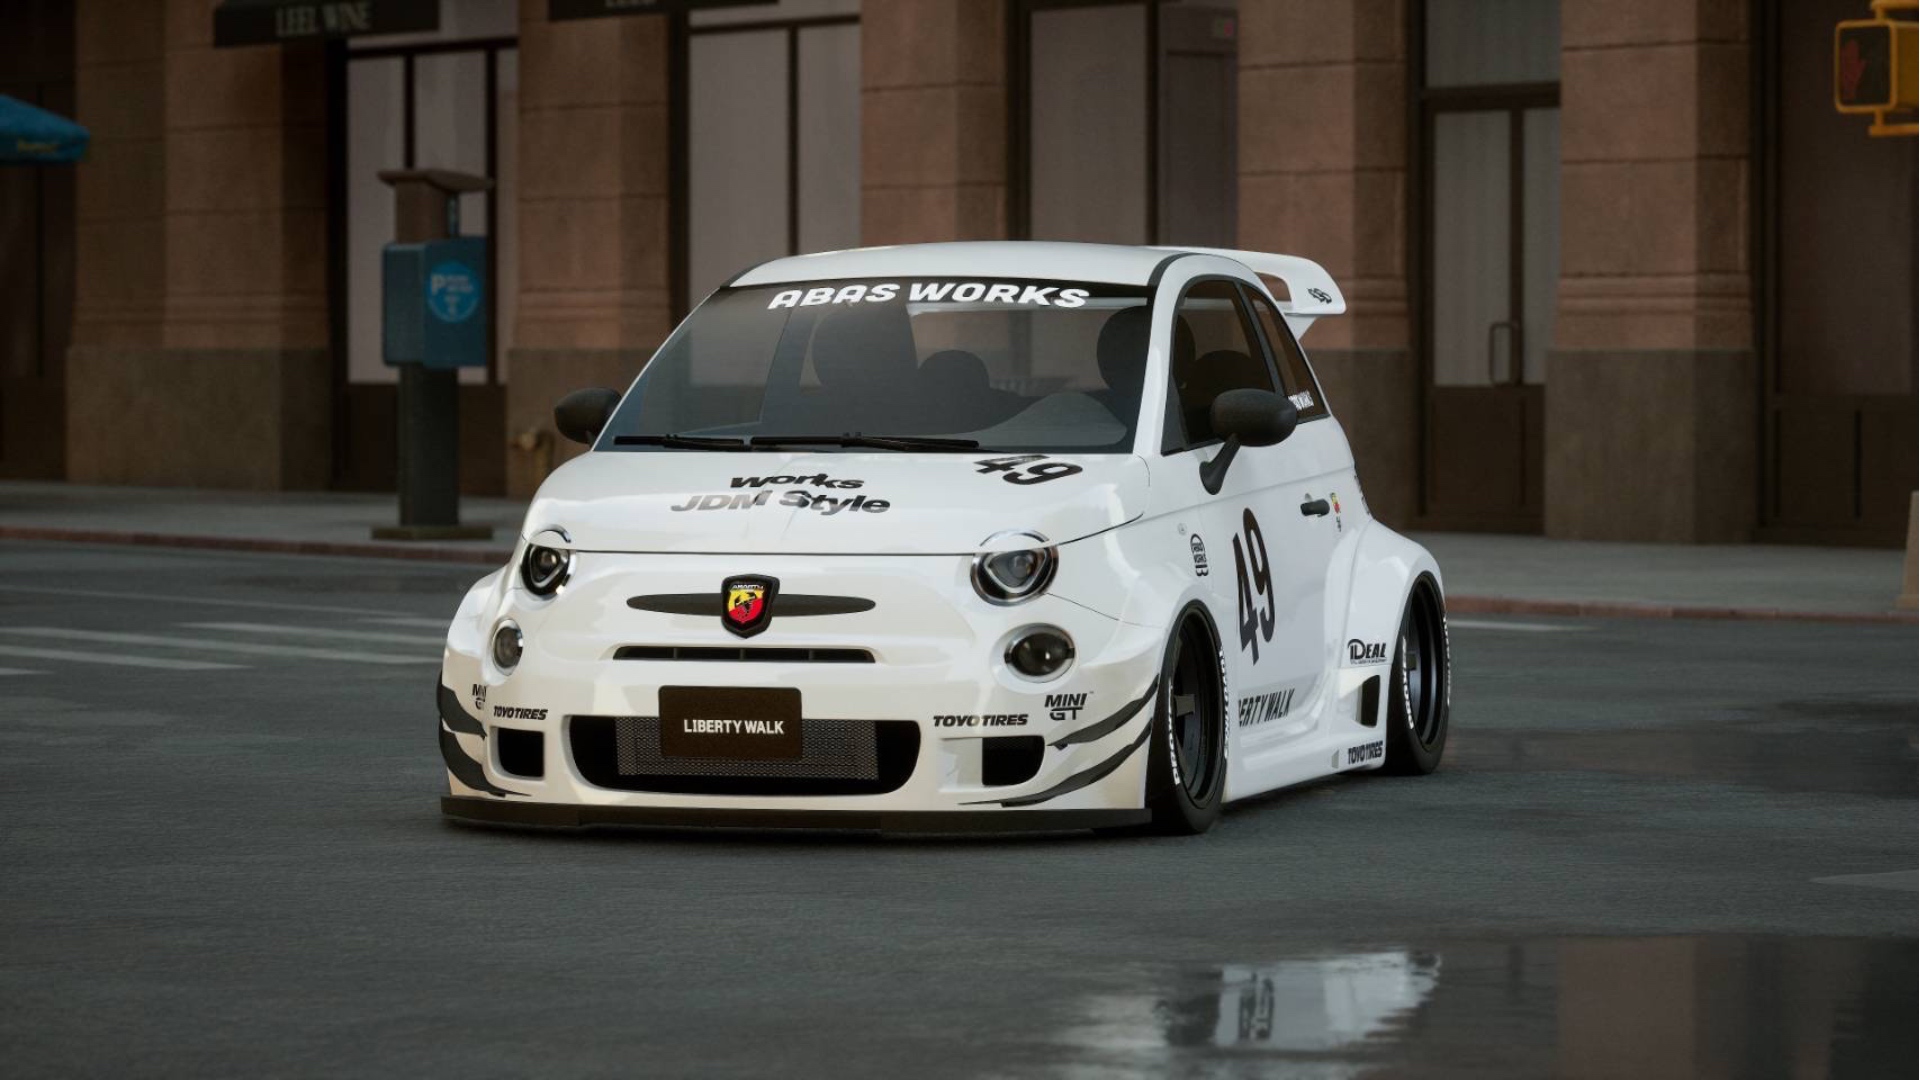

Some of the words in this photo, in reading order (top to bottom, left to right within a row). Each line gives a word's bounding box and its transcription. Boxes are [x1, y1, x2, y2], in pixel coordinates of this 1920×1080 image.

[767, 283, 901, 309] ABAS
[909, 282, 1091, 308] WORKS
[973, 454, 1083, 485] 49
[670, 490, 773, 512] JDM
[779, 490, 891, 516] Style
[1232, 508, 1276, 666] 49
[1044, 693, 1088, 708] MINI
[1264, 688, 1295, 722] WALK
[684, 718, 742, 734] LIBERTY
[744, 720, 785, 735] WALK
[1050, 708, 1083, 721] GT
